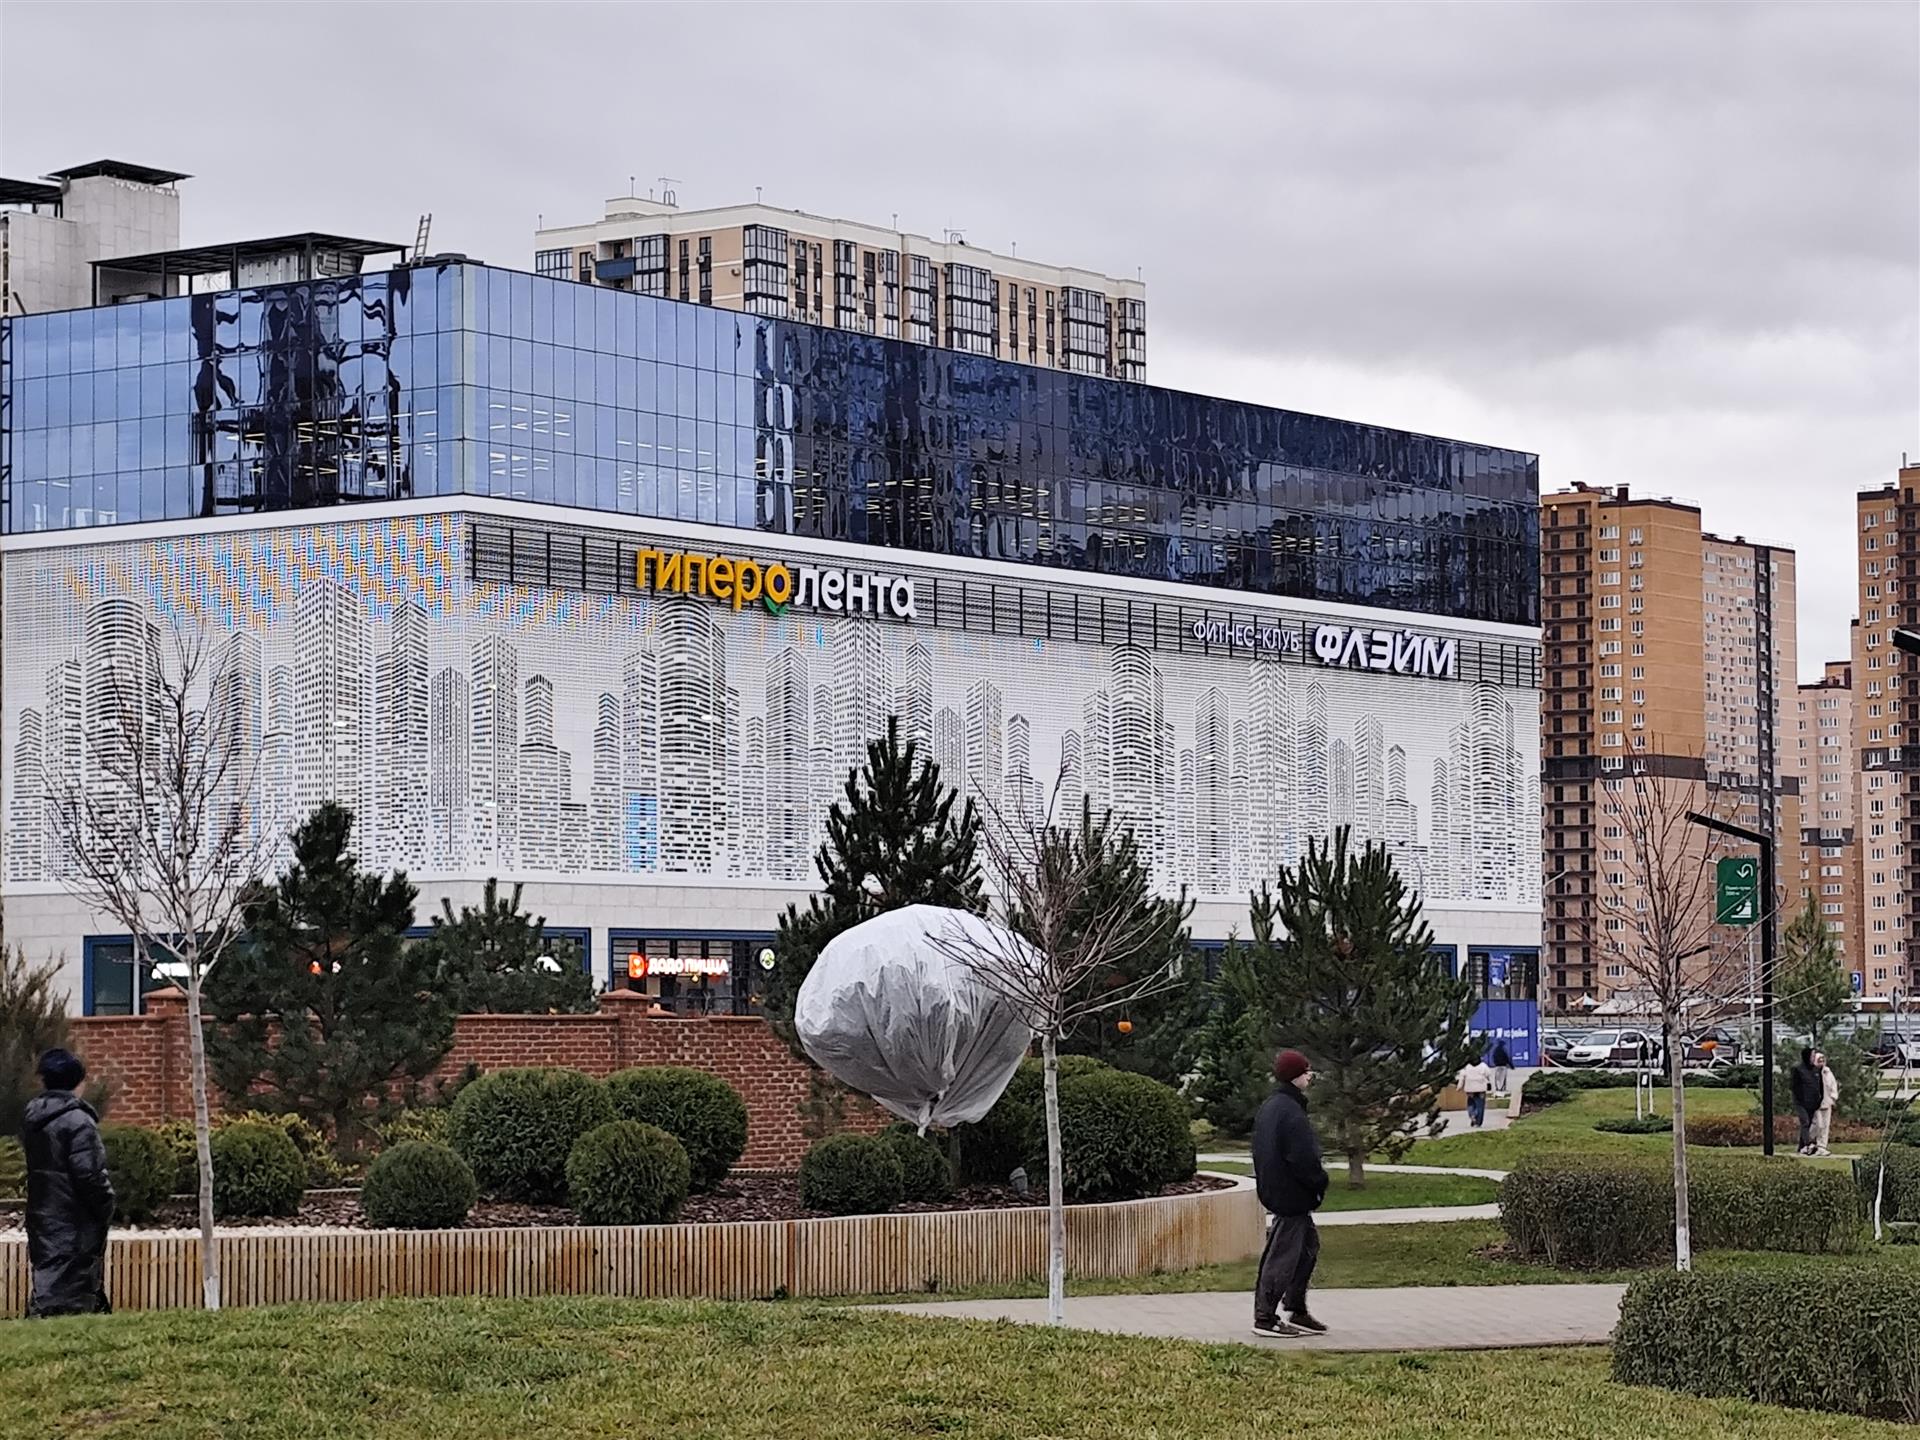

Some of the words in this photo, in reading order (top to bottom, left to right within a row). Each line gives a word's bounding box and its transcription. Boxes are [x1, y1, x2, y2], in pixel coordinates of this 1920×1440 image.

[794, 568, 917, 618] лента
[1193, 620, 1300, 652] ФИТНЕС-КЛУБ
[1314, 623, 1456, 676] ФЛЭЙМ
[647, 957, 684, 975] ДОДО
[685, 958, 729, 975] ПИЦЦА
